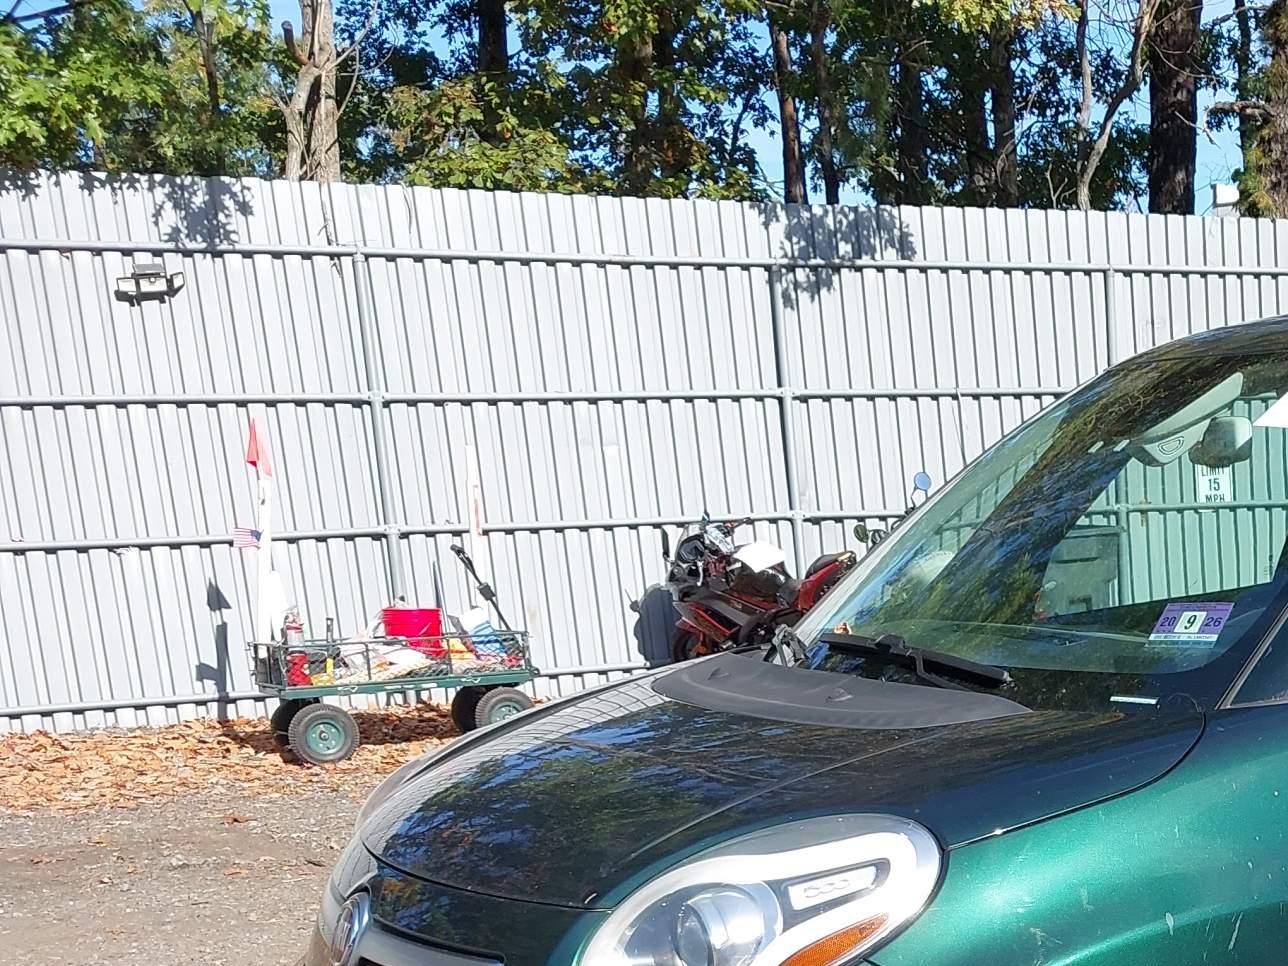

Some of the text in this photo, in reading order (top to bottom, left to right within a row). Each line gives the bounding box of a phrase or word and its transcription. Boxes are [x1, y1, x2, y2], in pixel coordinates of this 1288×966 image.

[1208, 478, 1221, 492] 15
[1205, 493, 1225, 504] MPH
[1160, 614, 1223, 630] 20 9 26
